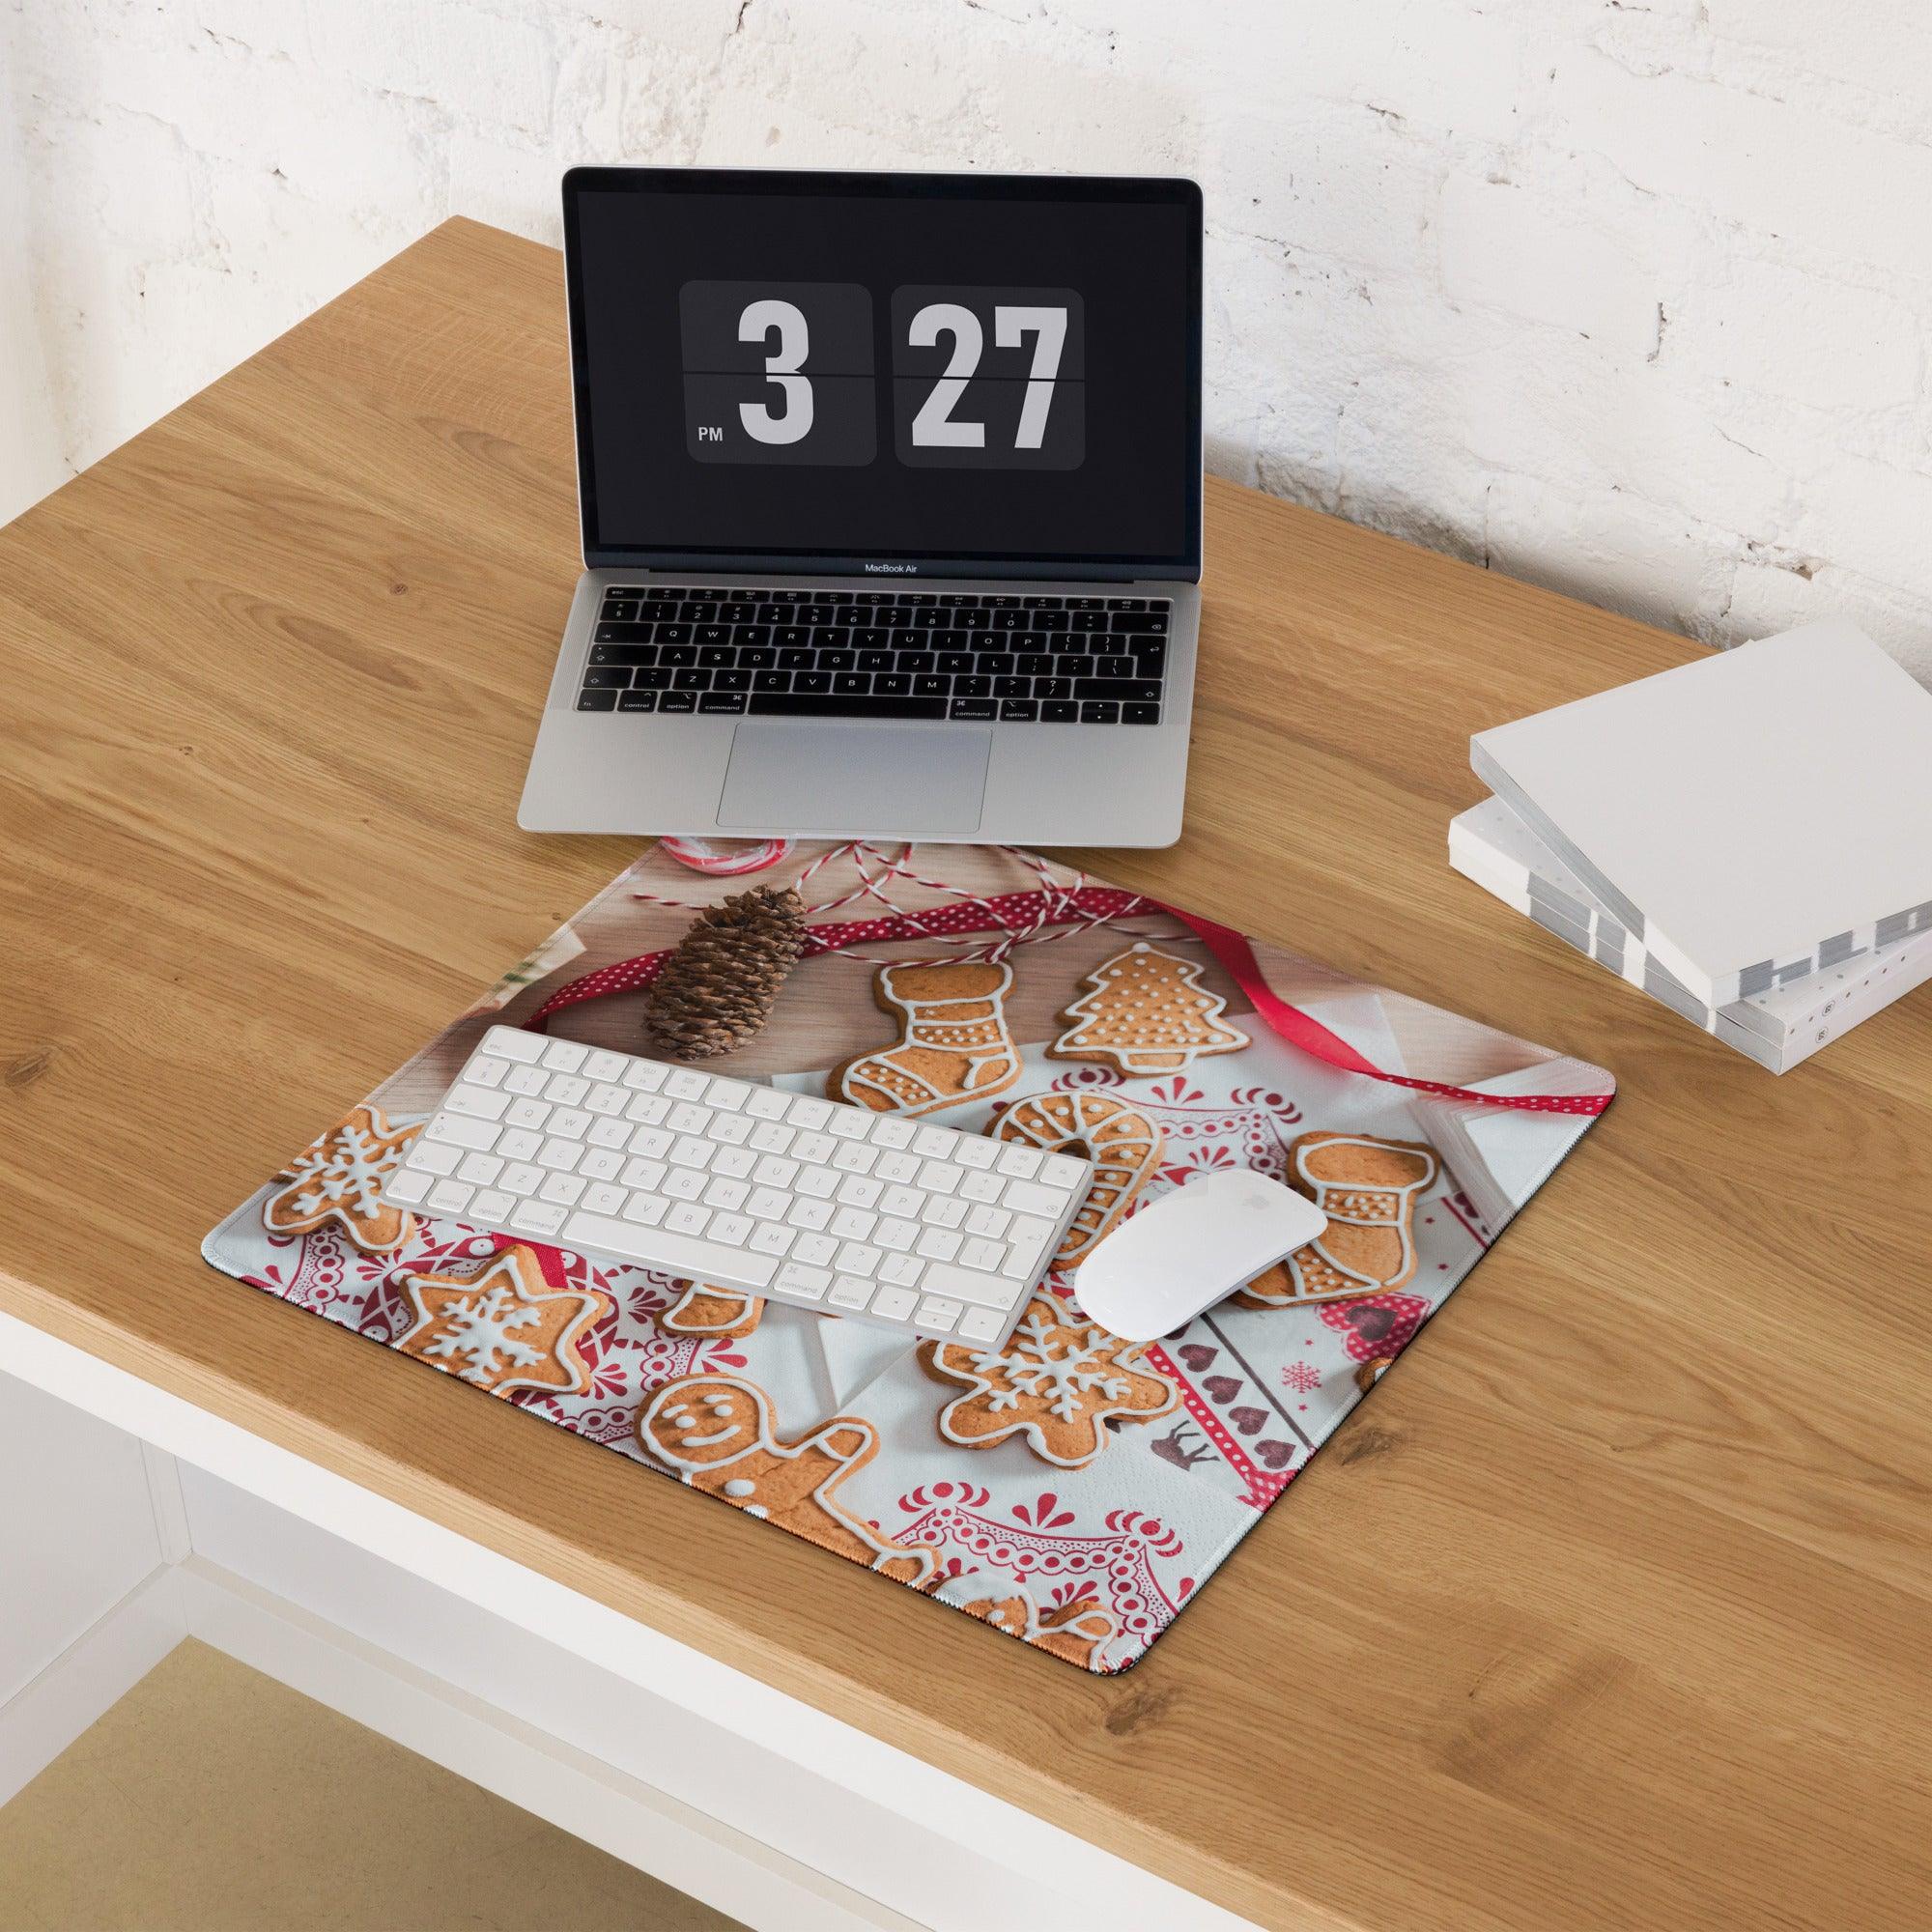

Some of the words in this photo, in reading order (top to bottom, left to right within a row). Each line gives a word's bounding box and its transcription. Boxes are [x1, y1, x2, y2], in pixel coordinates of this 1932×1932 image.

[738, 299, 814, 445] 3
[908, 303, 1068, 449] 27
[697, 426, 724, 441] PM
